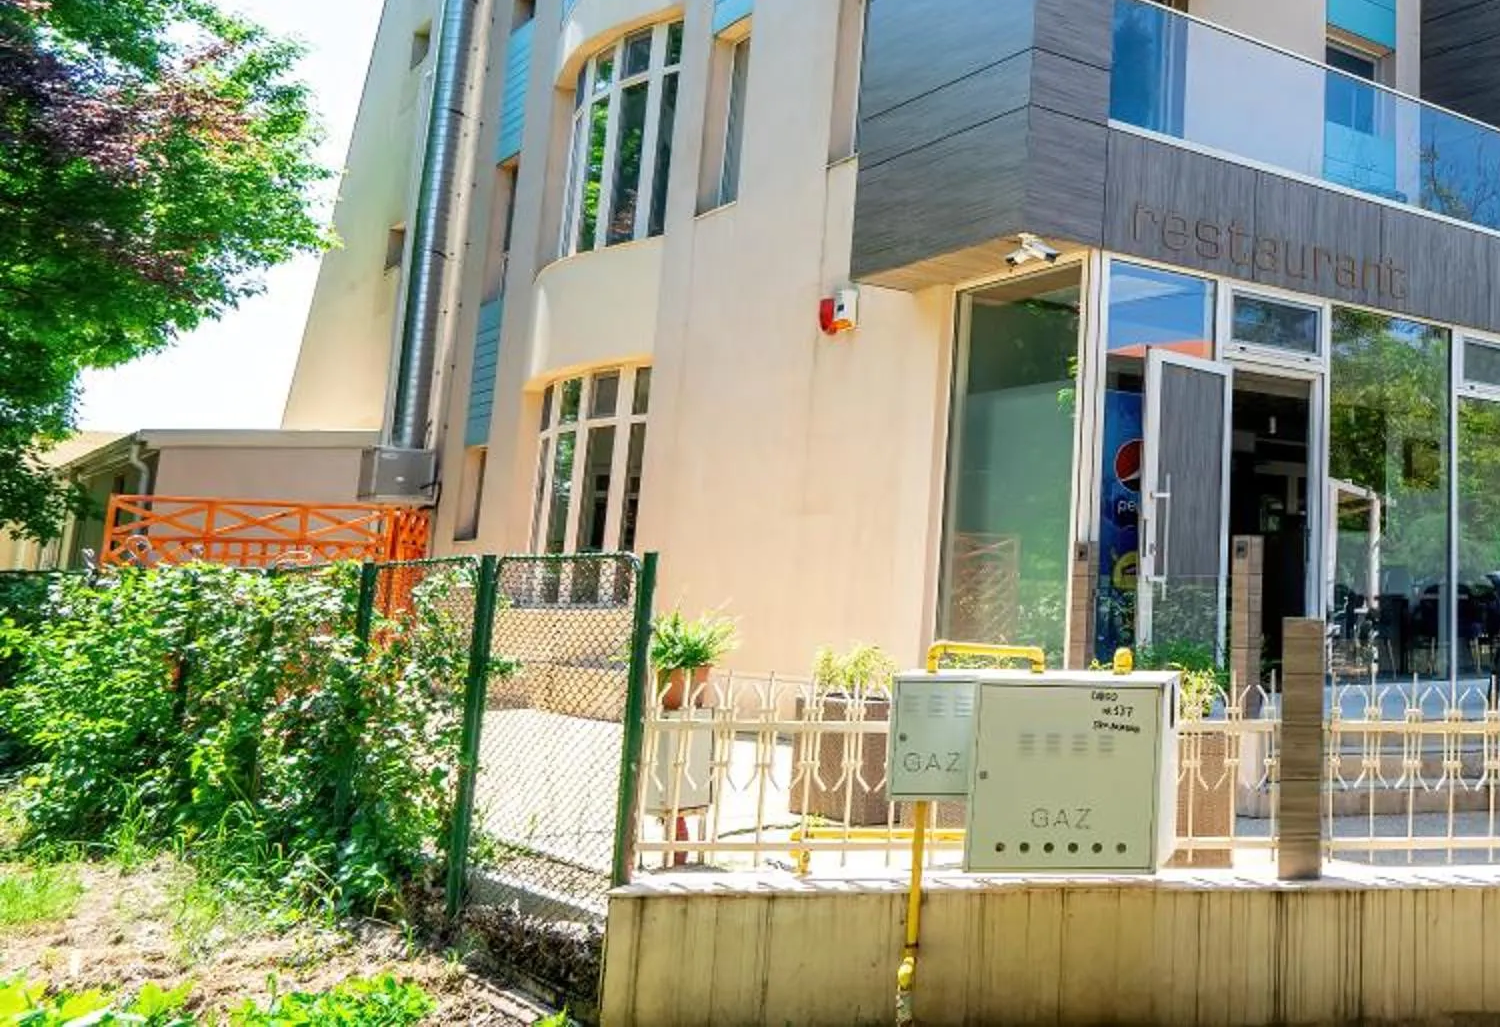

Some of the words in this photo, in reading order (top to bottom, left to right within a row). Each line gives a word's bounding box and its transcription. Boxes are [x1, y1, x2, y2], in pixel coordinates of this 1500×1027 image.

[1131, 203, 1409, 300] restaurant
[903, 751, 961, 773] GAZ
[1030, 807, 1093, 830] GAZ
